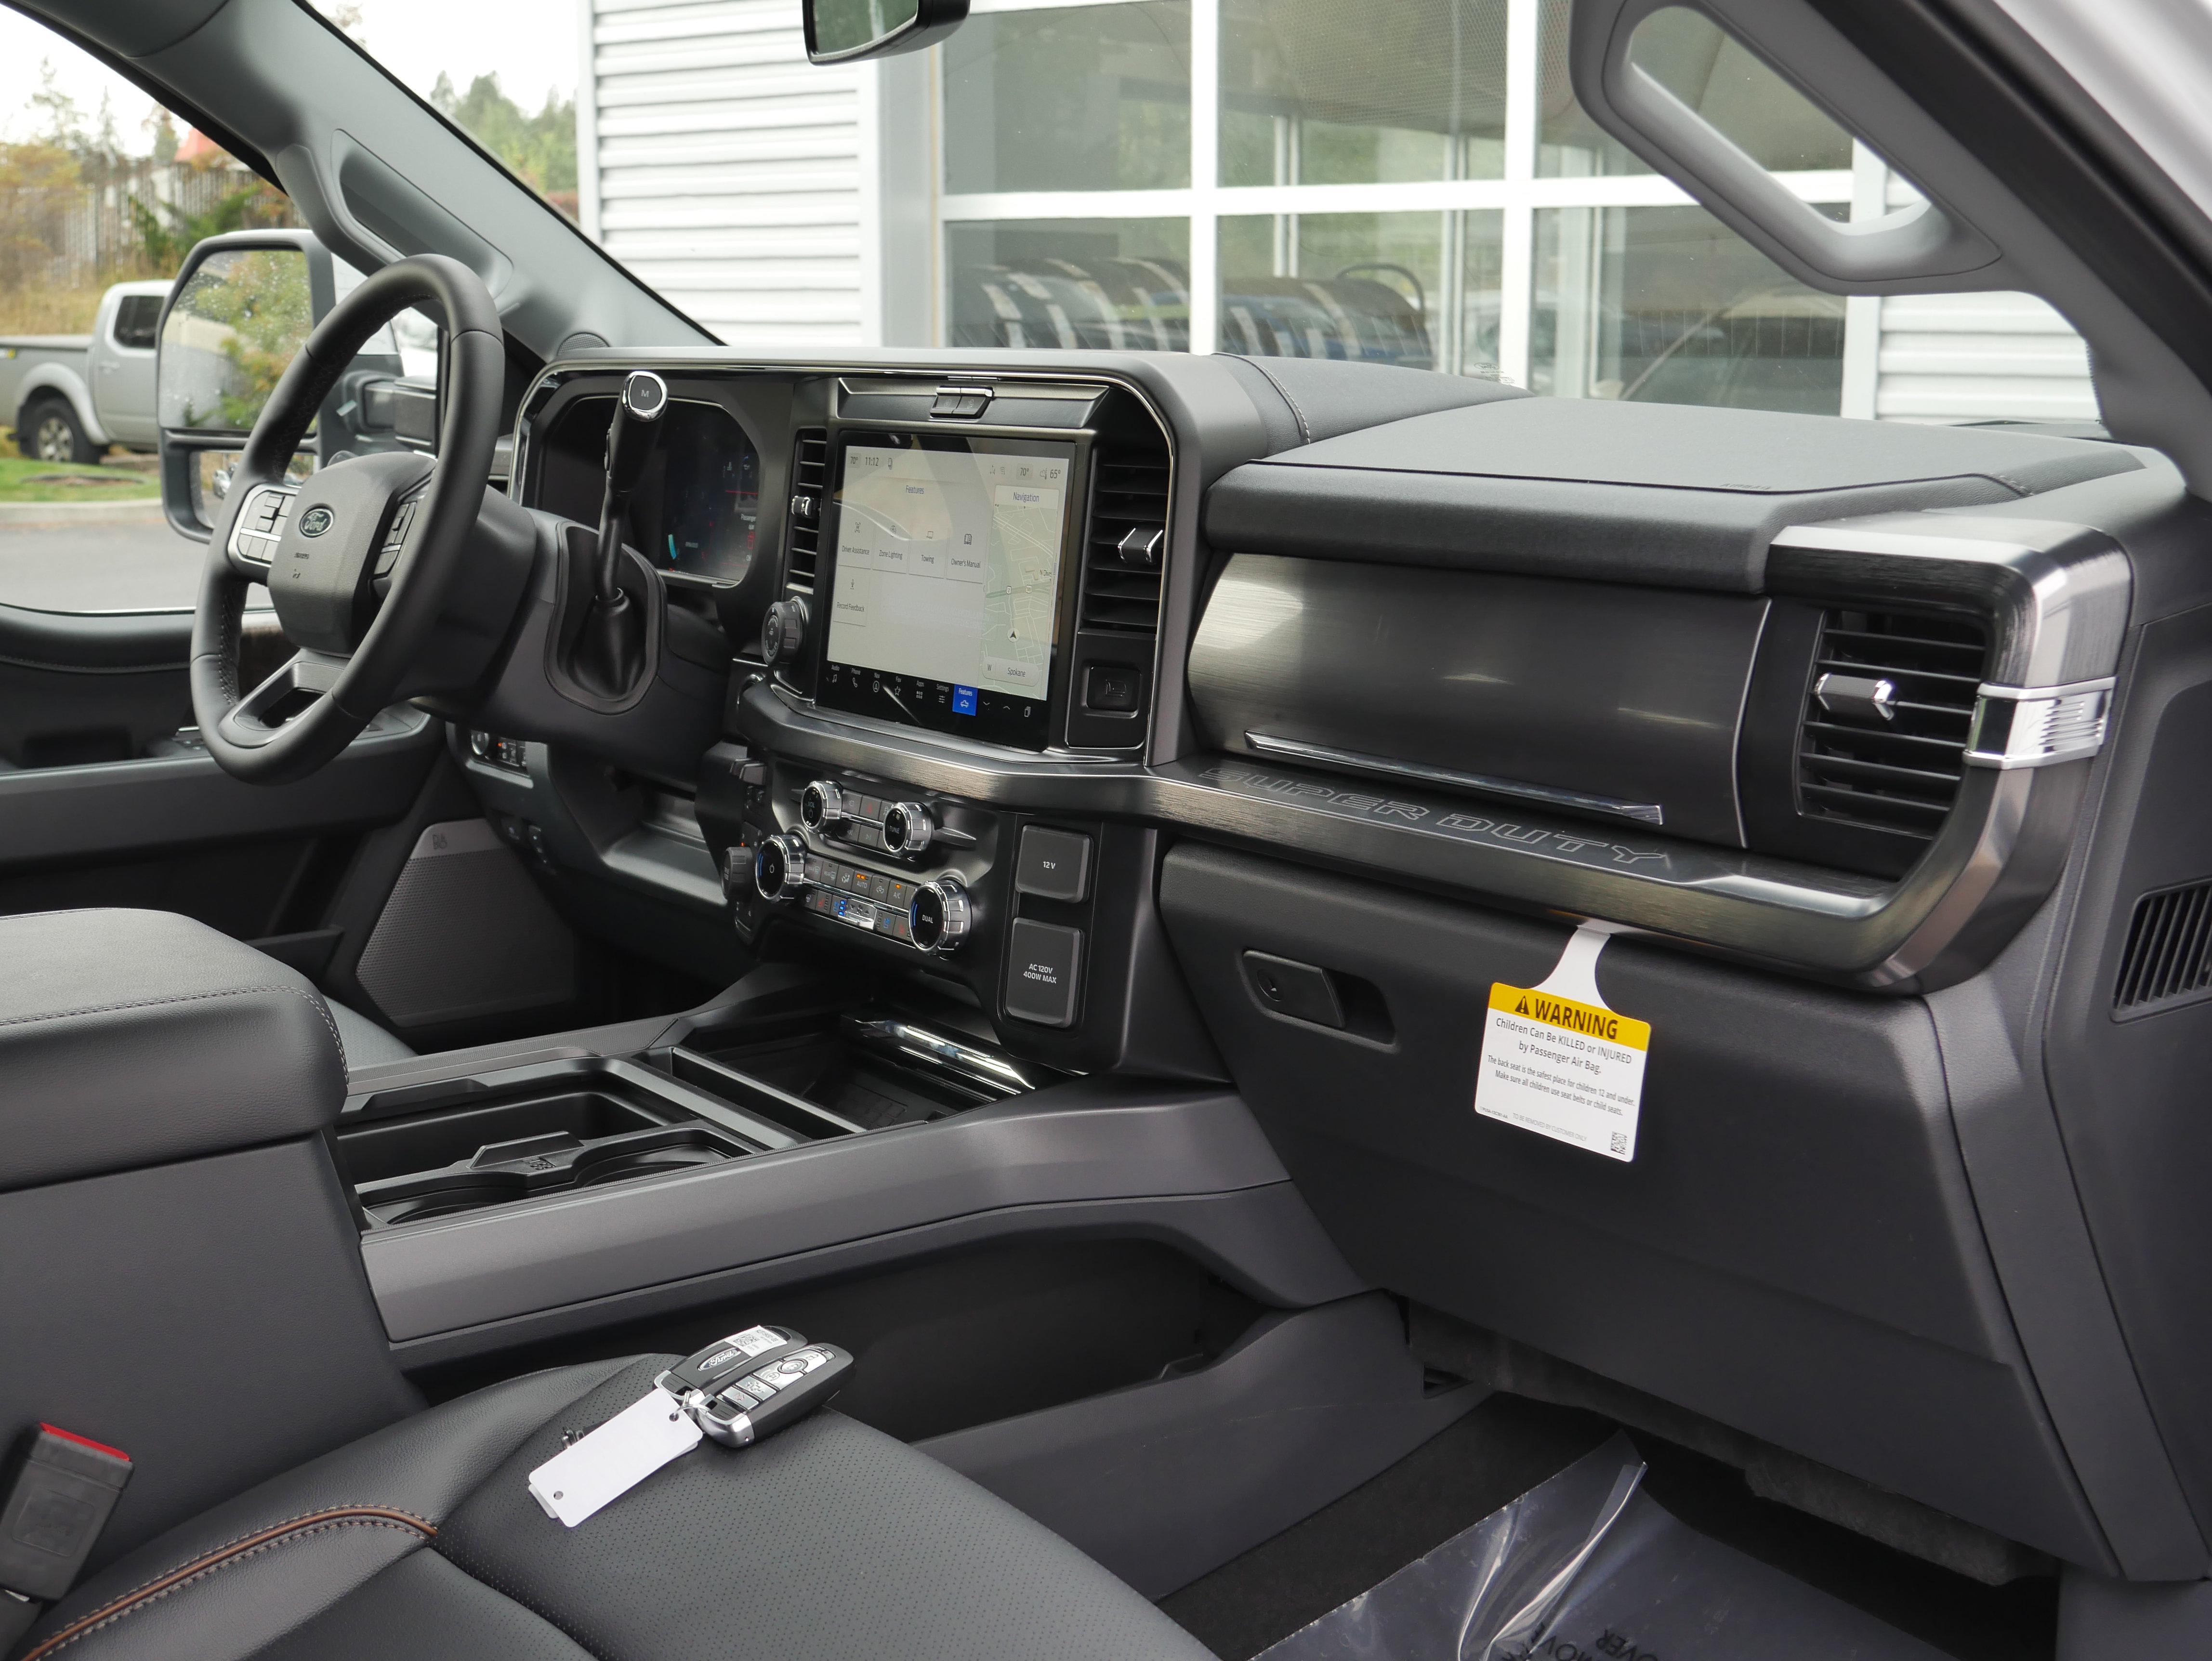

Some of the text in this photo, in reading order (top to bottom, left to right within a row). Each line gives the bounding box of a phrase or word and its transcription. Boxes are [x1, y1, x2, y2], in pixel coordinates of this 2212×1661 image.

[866, 457, 879, 466] 11:12
[1020, 467, 1029, 476] 70°
[1050, 469, 1061, 479] 65°
[906, 485, 924, 494] Features
[1013, 492, 1040, 502] Navigation
[842, 545, 870, 555] Driver Assistance
[879, 550, 903, 560] Zone Lighting
[921, 554, 934, 564] Towing
[951, 558, 981, 568] Owner's Manual
[837, 602, 865, 612] Record Feedback
[1008, 668, 1026, 677] Spokane
[936, 684, 949, 692] Settings
[959, 688, 973, 697] Features
[1199, 768, 1666, 864] SUPER DUTY
[890, 826, 900, 834] TUNE
[856, 881, 867, 889] AUTO
[922, 914, 934, 923] DUAL
[1038, 965, 1053, 974] 120V
[1023, 971, 1057, 984] 400W MAX
[1535, 998, 1619, 1040] WARNING
[1496, 1017, 1632, 1064] Children Can Be KILLED or INJURED
[1519, 1041, 1601, 1075] by Passenger Air Bag.
[1488, 1055, 1497, 1064] The
[1498, 1057, 1509, 1068] back
[1522, 1065, 1526, 1073] is
[1527, 1067, 1536, 1076] the
[1537, 1071, 1552, 1081] safest
[1553, 1075, 1566, 1085] place
[1576, 1081, 1597, 1094] children
[1599, 1089, 1605, 1097] 12
[1606, 1092, 1616, 1101] and
[1618, 1095, 1635, 1107] under.
[1495, 1070, 1509, 1081] Make
[1510, 1076, 1521, 1084] sure
[1529, 1081, 1550, 1093] children
[1551, 1088, 1560, 1096] use
[1561, 1091, 1572, 1100] seat
[1573, 1094, 1585, 1105] belts
[1593, 1100, 1606, 1111] child
[1607, 1106, 1623, 1116] seats.
